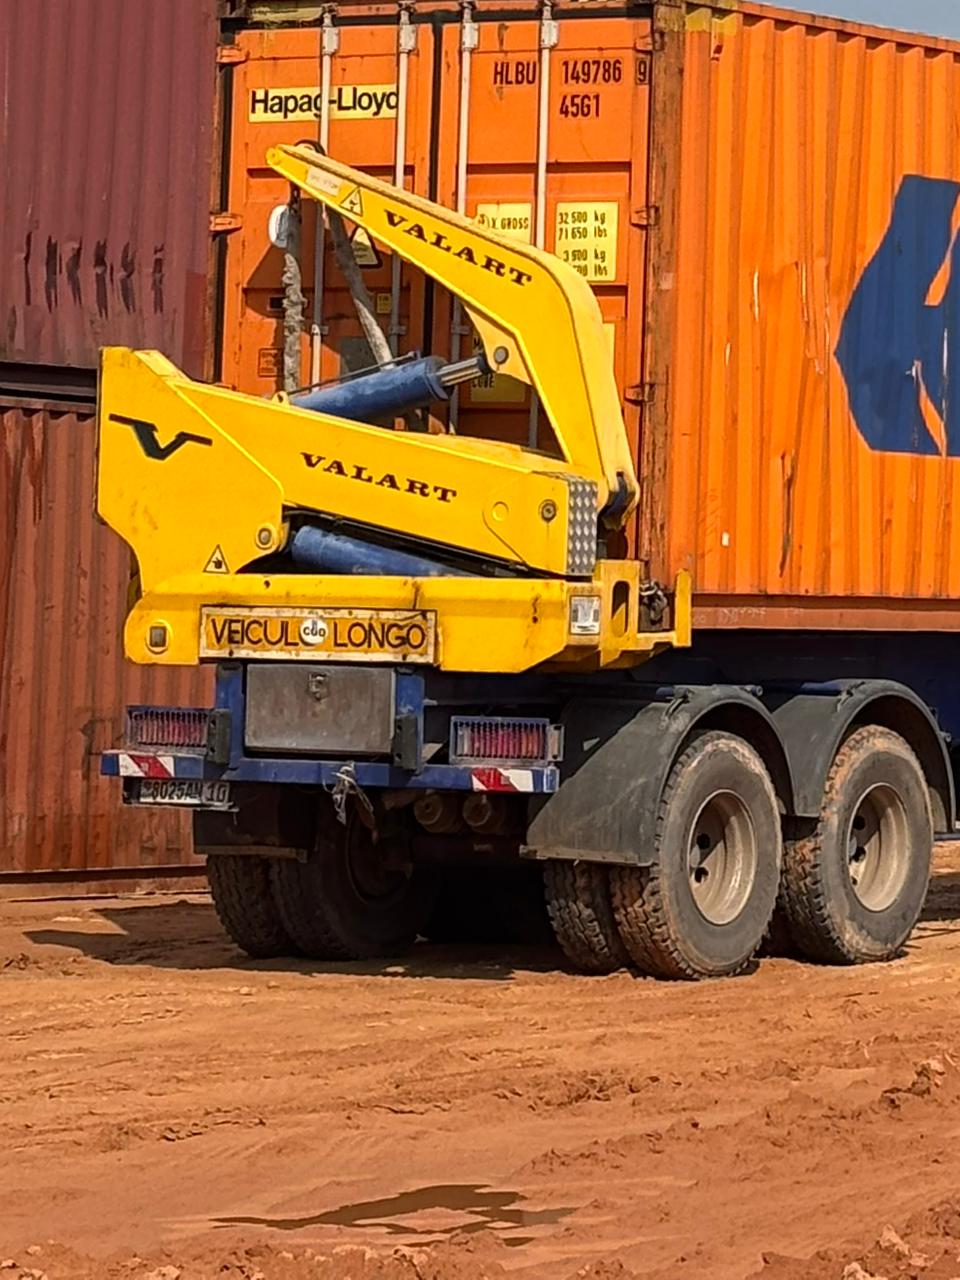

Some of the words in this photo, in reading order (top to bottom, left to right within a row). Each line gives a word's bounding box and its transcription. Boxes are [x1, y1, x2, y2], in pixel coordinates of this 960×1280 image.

[493, 61, 537, 85] HLBU
[562, 59, 622, 85] 149786
[559, 94, 600, 118] 45G1
[594, 210, 606, 225] kg
[384, 209, 533, 286] VALART
[300, 452, 458, 503] VALART
[212, 618, 312, 646] VEICUL
[333, 621, 426, 649] LONGO
